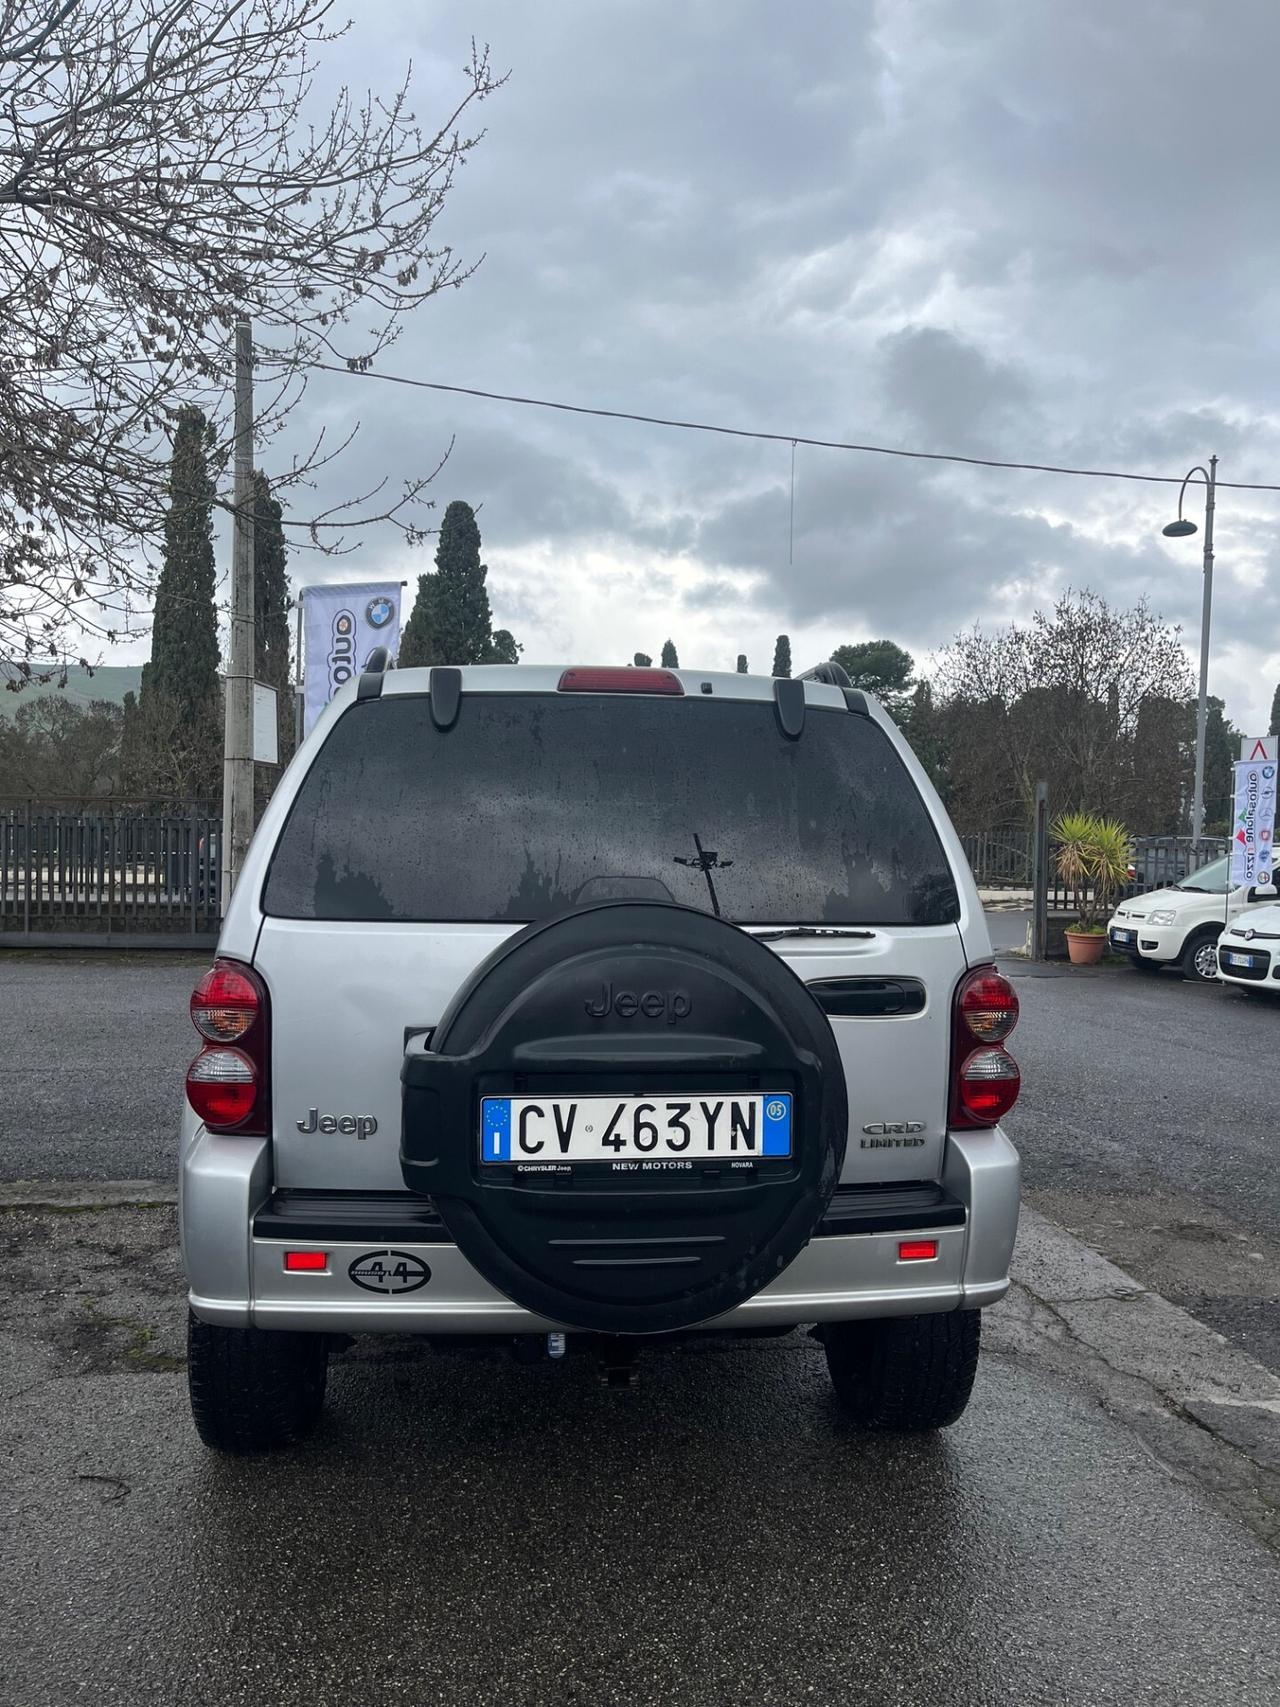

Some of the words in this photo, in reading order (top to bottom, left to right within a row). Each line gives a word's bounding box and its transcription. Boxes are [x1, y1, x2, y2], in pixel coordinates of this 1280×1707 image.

[585, 982, 692, 1025] Jeep
[296, 1107, 378, 1140] Jeep
[519, 1103, 578, 1154] CV
[601, 1101, 757, 1152] 463YN
[862, 1121, 927, 1135] CRD
[860, 1137, 926, 1149] LIMITED
[612, 1162, 639, 1171] NEW
[642, 1161, 693, 1170] MOTORS
[731, 1161, 754, 1169] NOVARA
